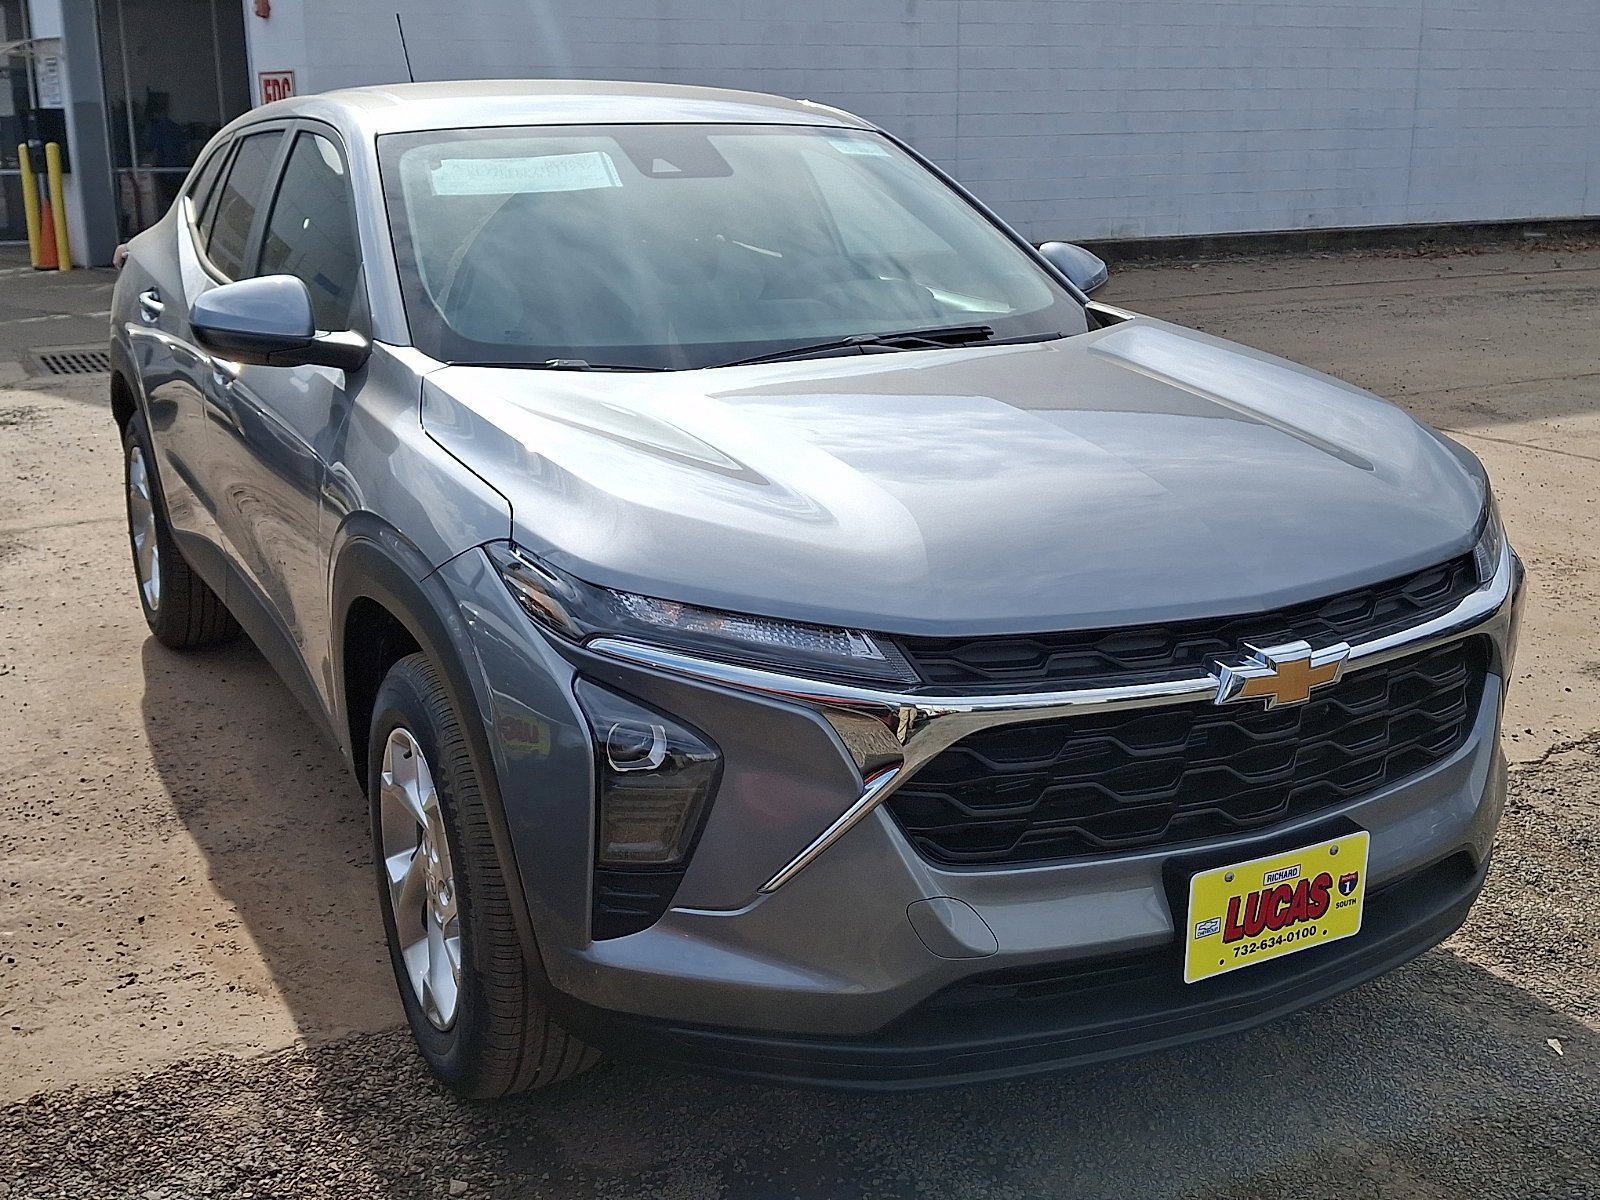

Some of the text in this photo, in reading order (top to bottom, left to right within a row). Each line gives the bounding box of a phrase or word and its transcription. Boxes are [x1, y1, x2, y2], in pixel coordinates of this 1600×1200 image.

[1267, 867, 1298, 883] RICHARD
[1344, 881, 1351, 894] 1
[1222, 872, 1333, 944] LUCAS
[1335, 898, 1357, 909] SOUTH
[1233, 925, 1317, 958] 732-634-0100
